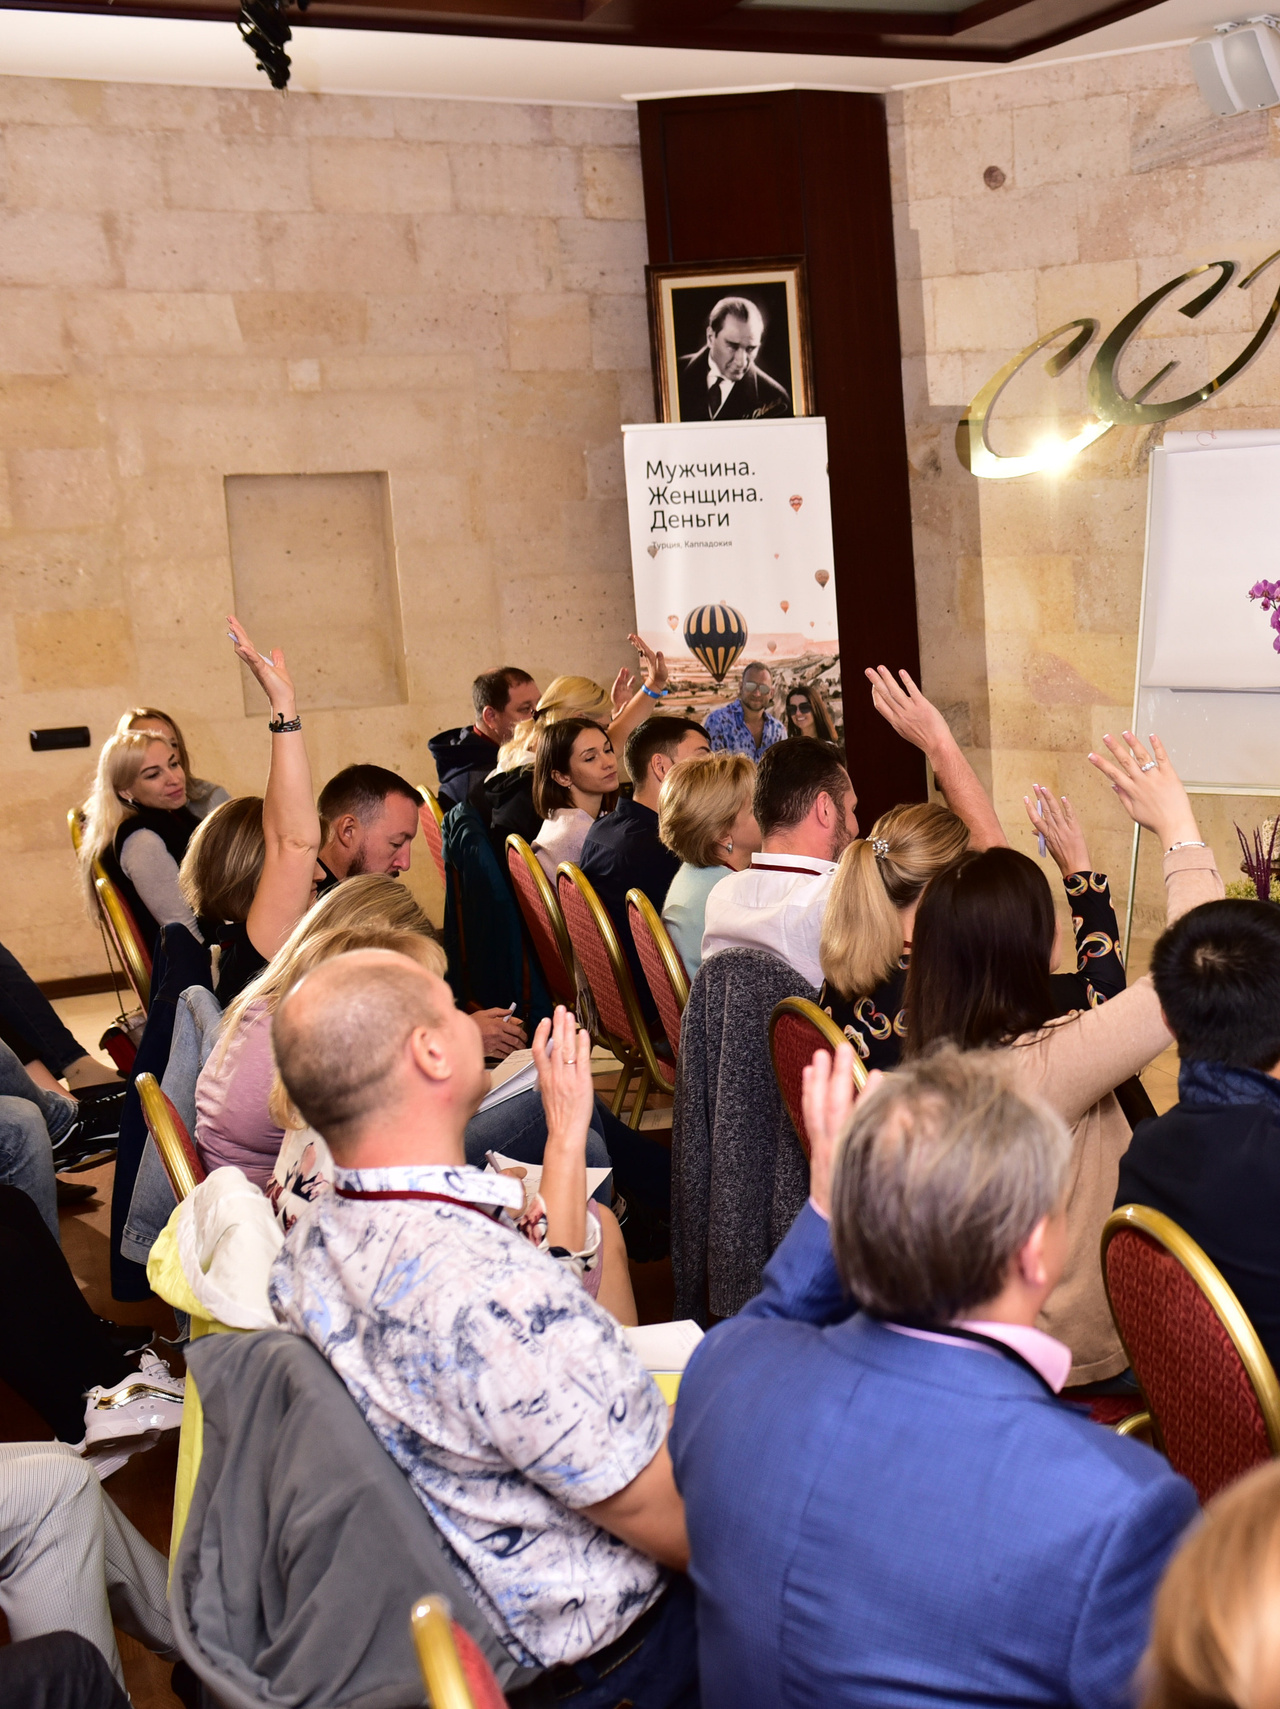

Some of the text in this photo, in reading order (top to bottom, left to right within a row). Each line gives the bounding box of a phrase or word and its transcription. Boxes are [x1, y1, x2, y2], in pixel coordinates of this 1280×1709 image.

[646, 460, 755, 484] Мужчина.
[648, 486, 763, 506] Женщина.
[650, 510, 730, 533] Деньги
[684, 540, 733, 549] Каппадокия
